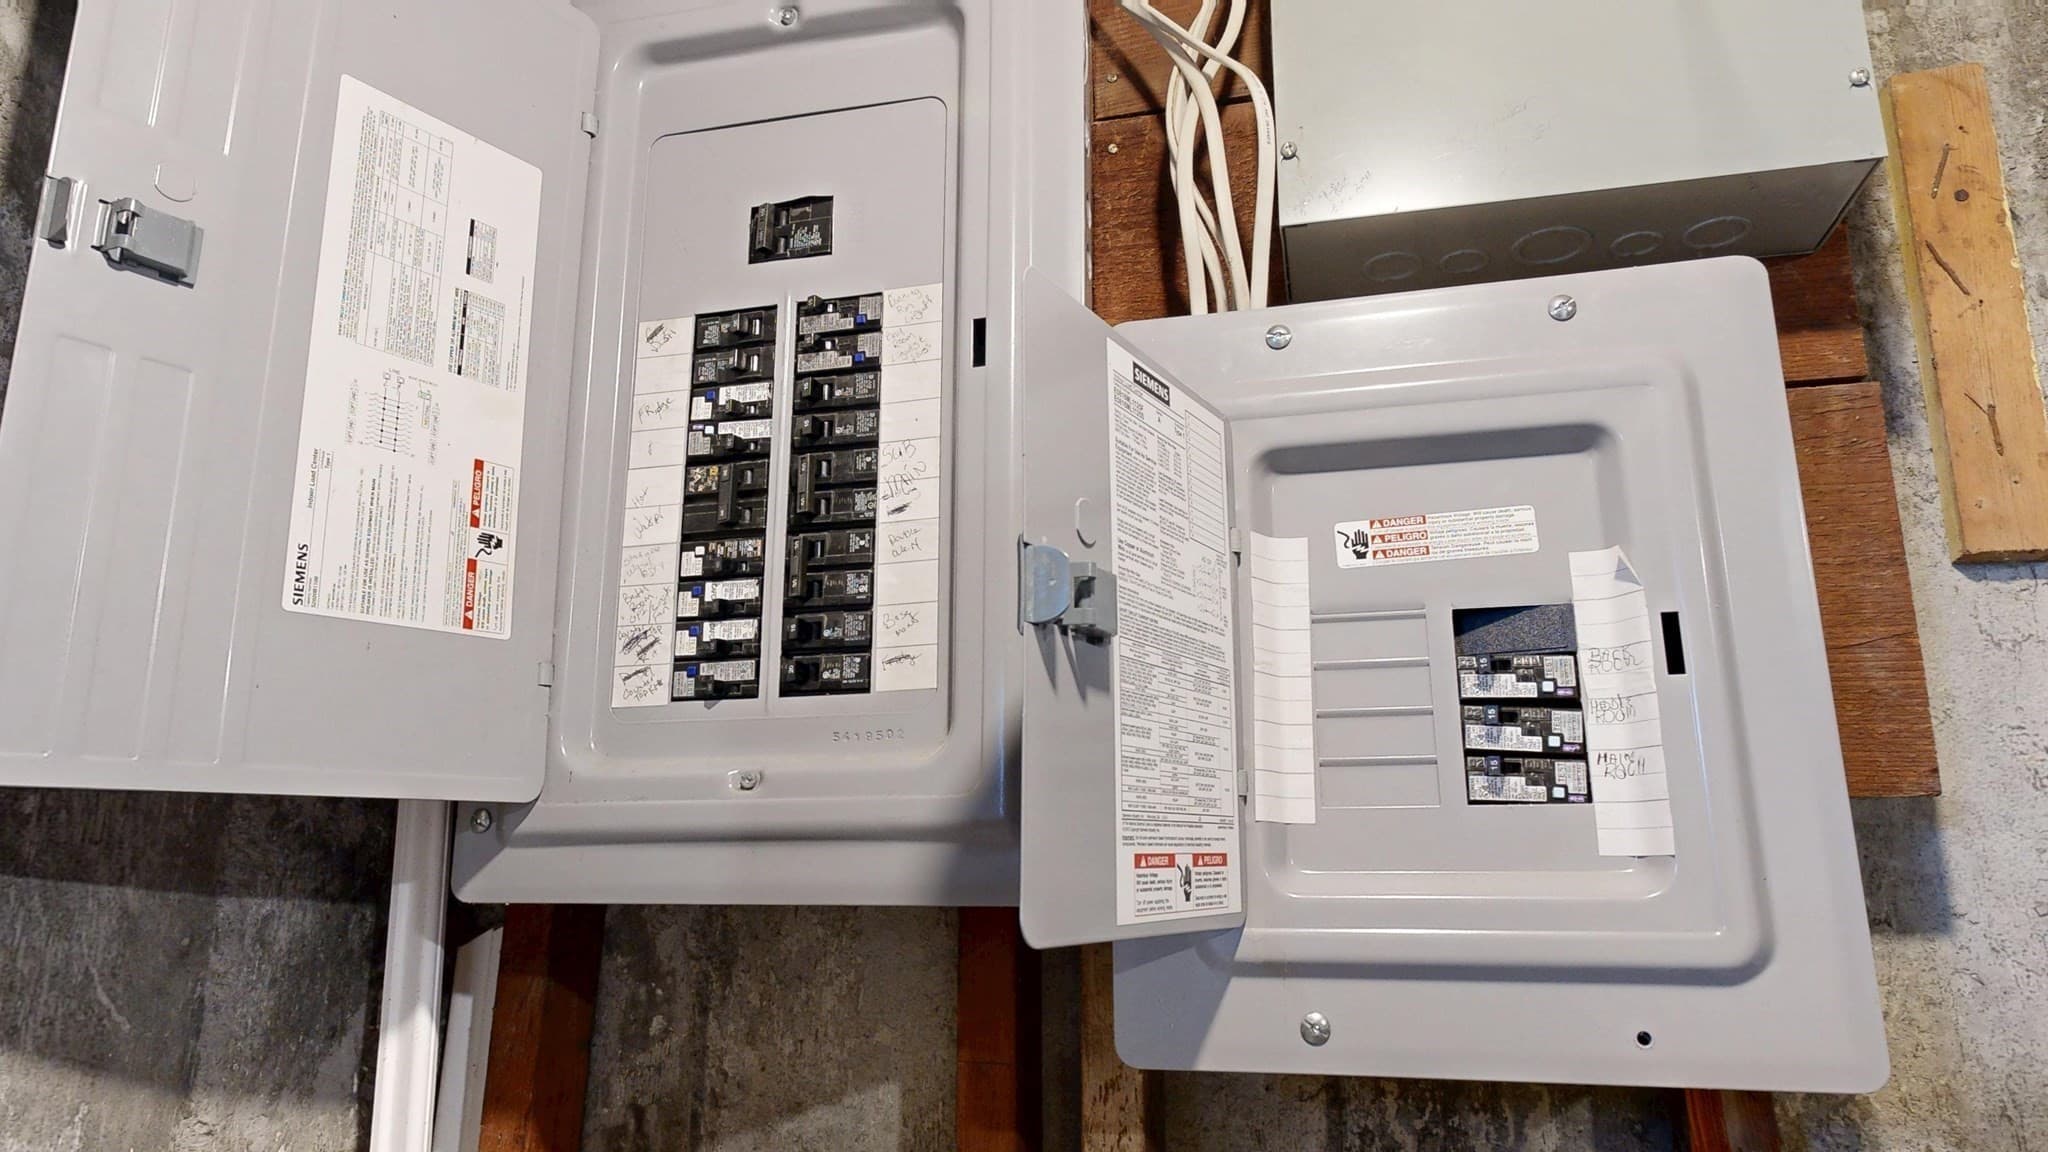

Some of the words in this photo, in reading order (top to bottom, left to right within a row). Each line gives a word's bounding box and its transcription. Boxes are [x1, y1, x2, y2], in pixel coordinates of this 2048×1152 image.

[1134, 367, 1170, 401] SIEMENS
[472, 470, 482, 507] PELIGRO
[1383, 516, 1424, 527] DANGER
[1384, 531, 1427, 543] PELIGRO
[1386, 547, 1428, 558] DANGER
[292, 543, 309, 606] SIEMENS
[464, 571, 475, 608] DANGER
[1147, 855, 1169, 866] DANGER
[1203, 854, 1223, 865] PELIGRO
